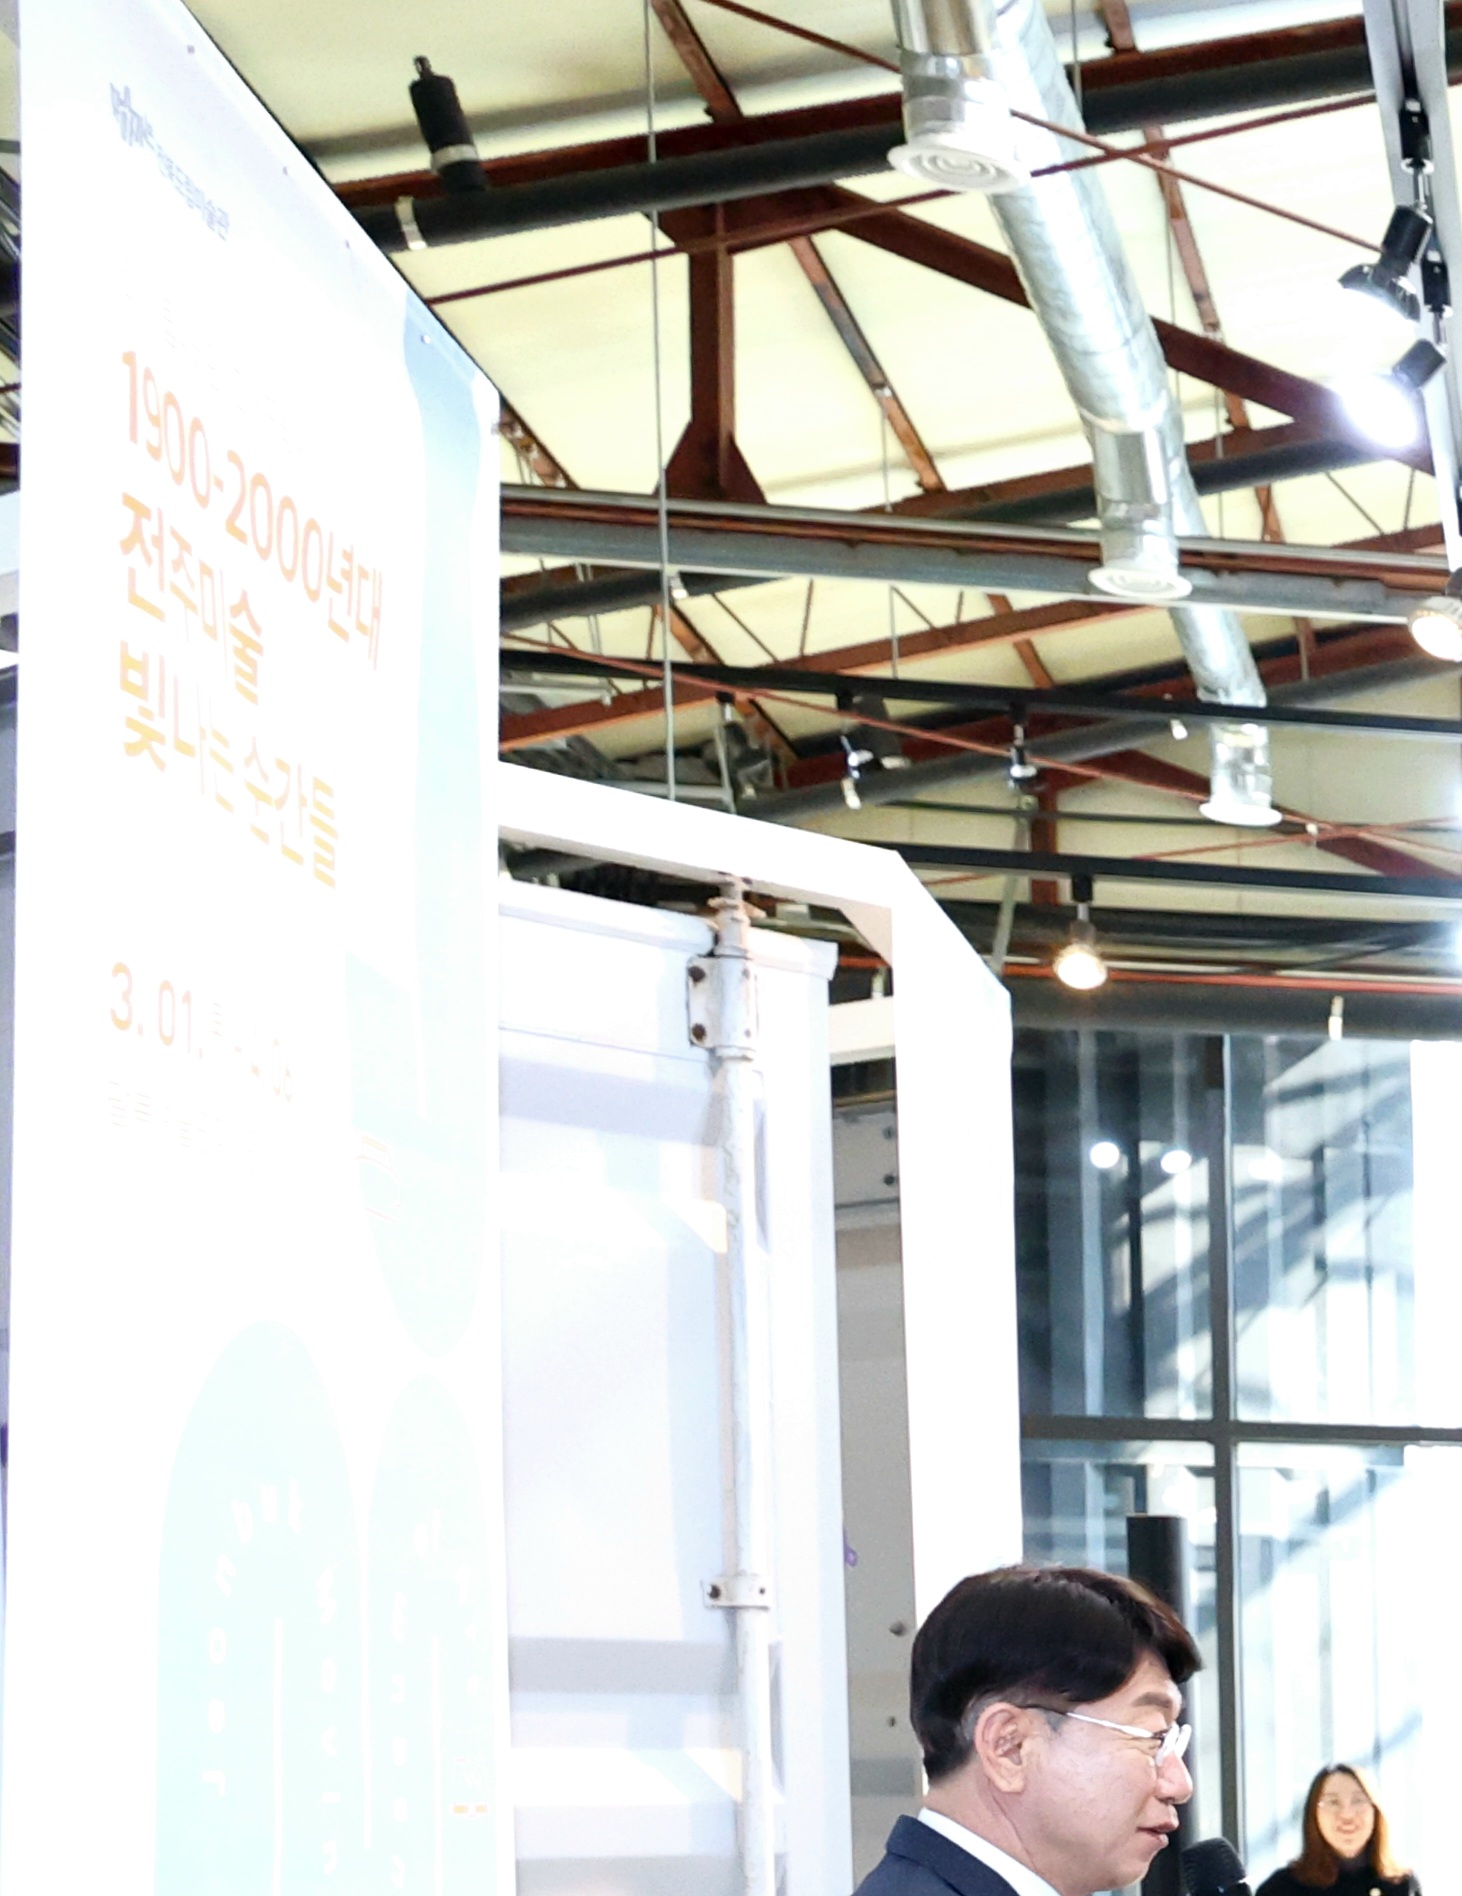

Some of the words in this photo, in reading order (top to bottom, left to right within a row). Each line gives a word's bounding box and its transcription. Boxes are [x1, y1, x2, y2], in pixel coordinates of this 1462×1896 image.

[119, 492, 264, 706] 전주미술
[121, 351, 382, 671] 1900-2000년대
[244, 736, 338, 890] 순간들
